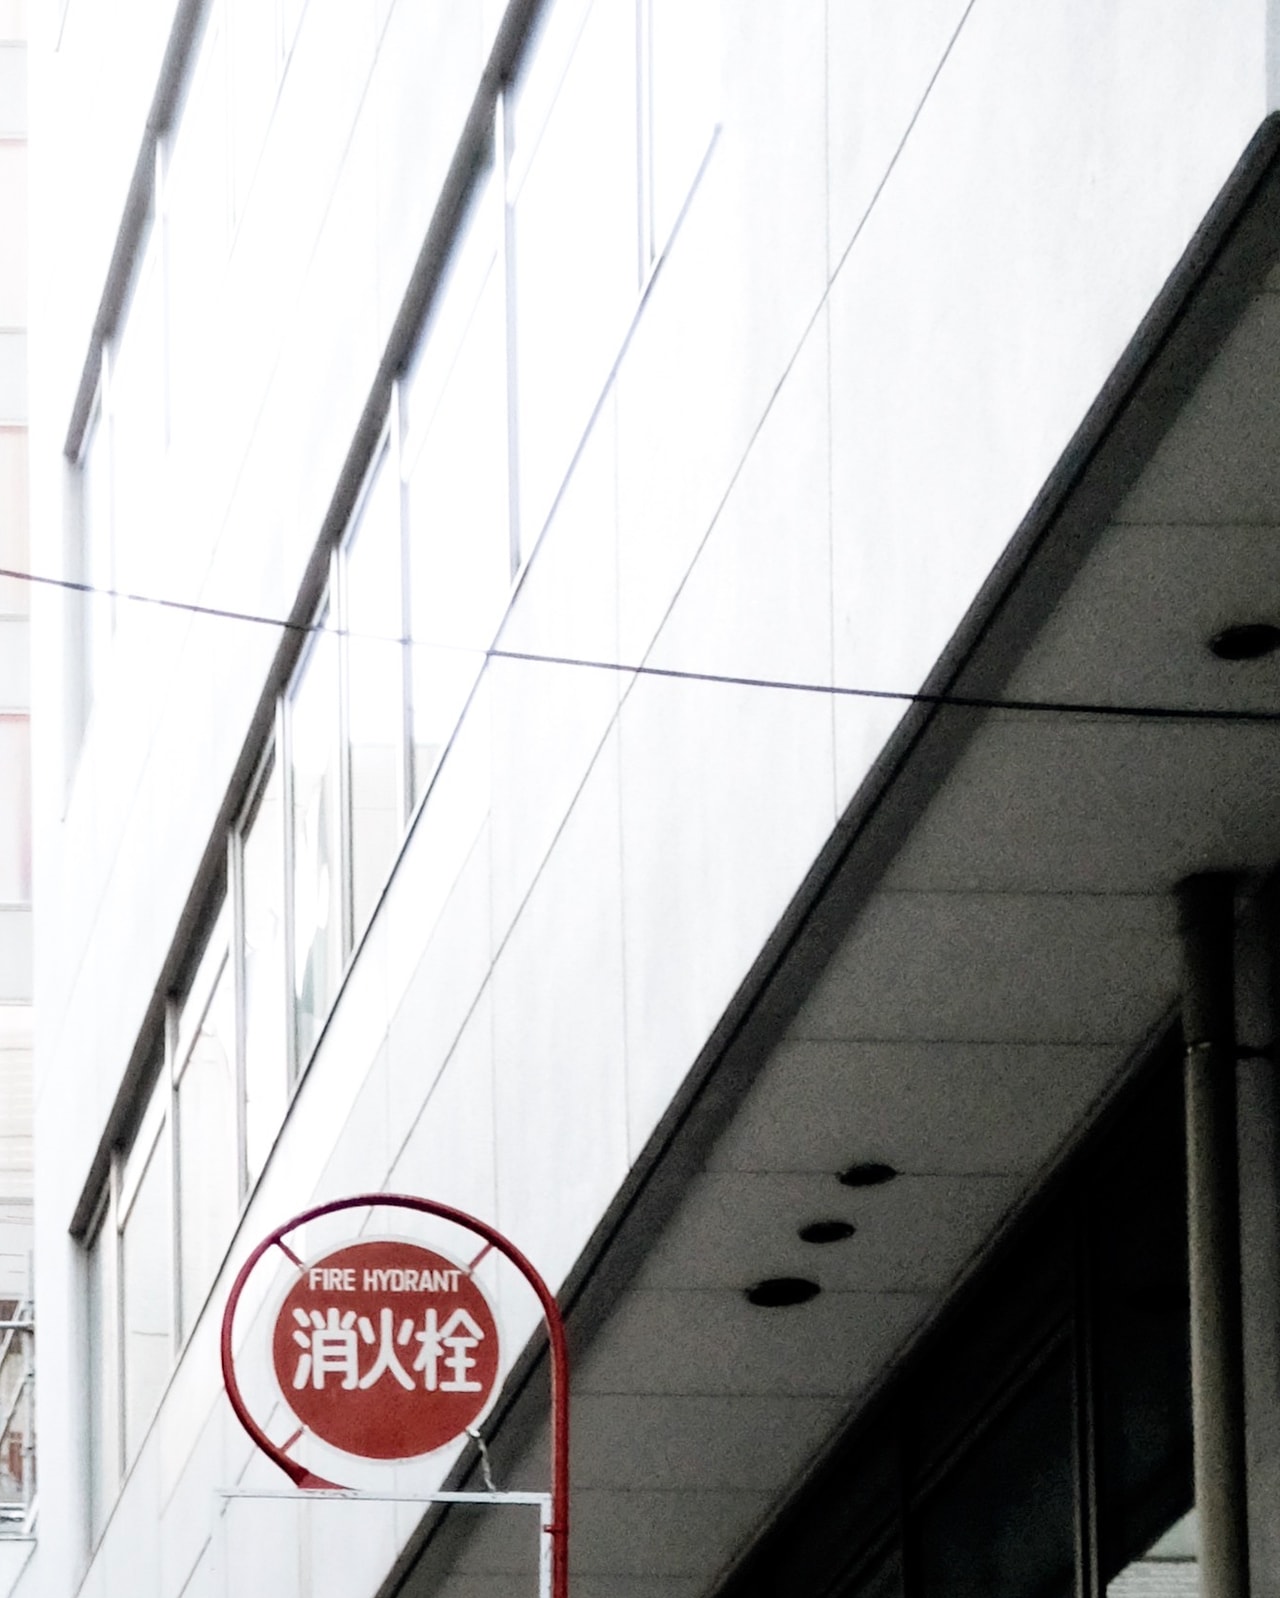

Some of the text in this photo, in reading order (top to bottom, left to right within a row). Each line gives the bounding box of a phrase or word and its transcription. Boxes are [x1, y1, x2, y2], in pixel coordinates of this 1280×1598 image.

[309, 1268, 463, 1293] FIRE HYDRANT
[291, 1307, 485, 1393] 消火栓
